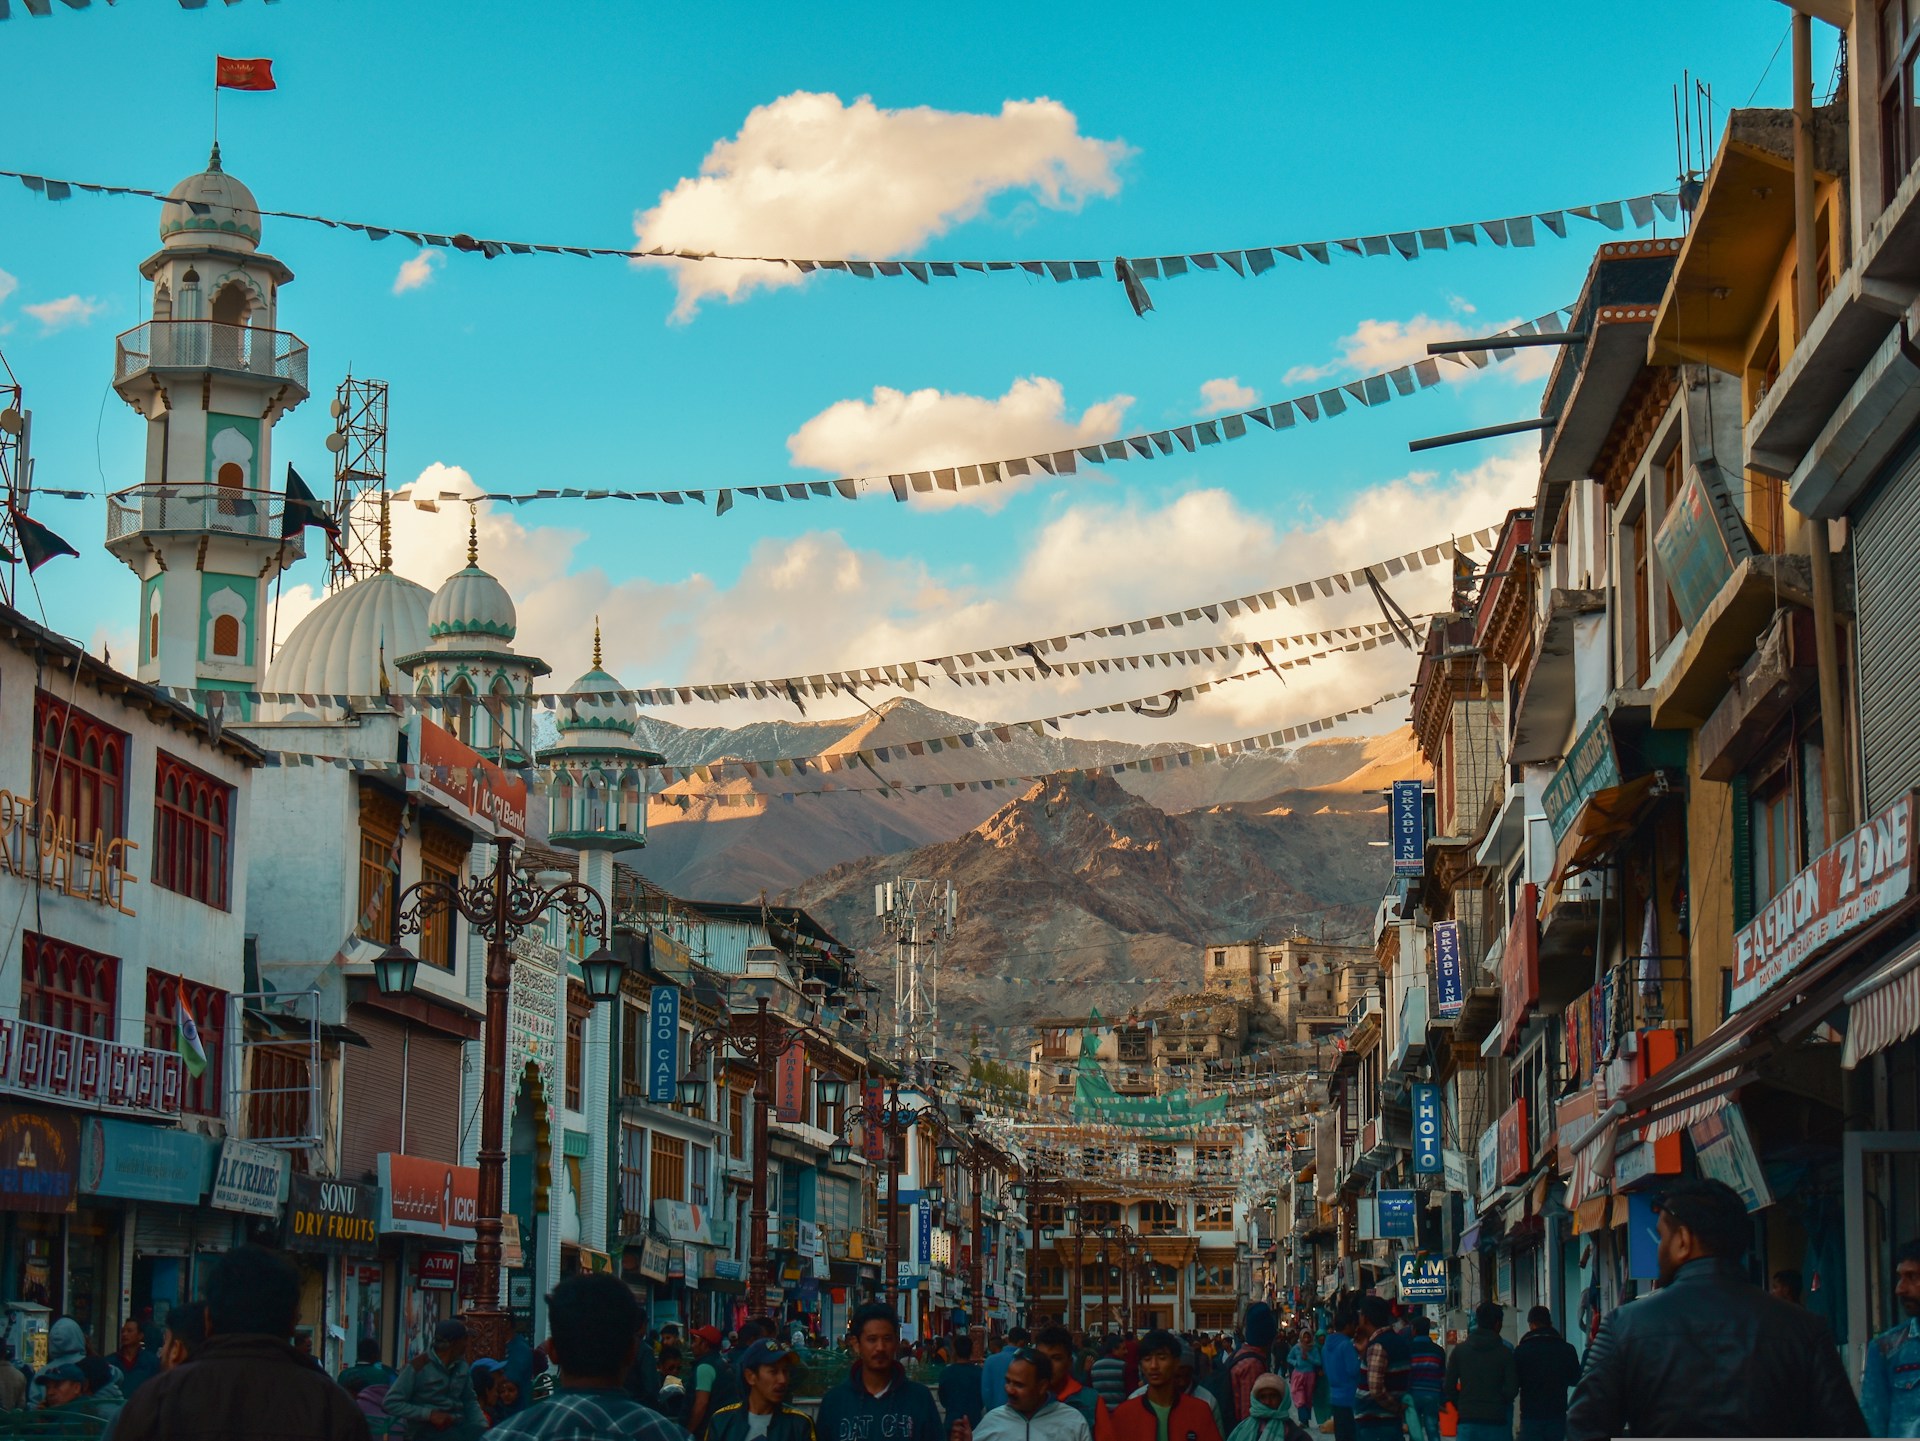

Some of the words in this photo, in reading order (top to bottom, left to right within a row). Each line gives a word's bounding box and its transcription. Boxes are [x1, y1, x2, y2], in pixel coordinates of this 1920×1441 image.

[504, 801, 525, 832] Bank
[1401, 789, 1415, 834] SKYABU
[40, 808, 139, 917] PALACE
[1403, 837, 1415, 859] INN
[1736, 861, 1820, 981] FASHION
[1839, 799, 1908, 898] ZONE
[1441, 930, 1453, 976] SKYABU
[1445, 979, 1455, 1002] INN
[657, 989, 673, 1040] AMDO
[657, 1049, 670, 1099] CAFE
[1420, 1088, 1436, 1167] PHOTO
[320, 1182, 357, 1214] SONU
[454, 1196, 476, 1222] ICICI
[294, 1210, 324, 1236] DRY
[328, 1215, 375, 1242] FRUITS
[425, 1257, 454, 1270] ATM
